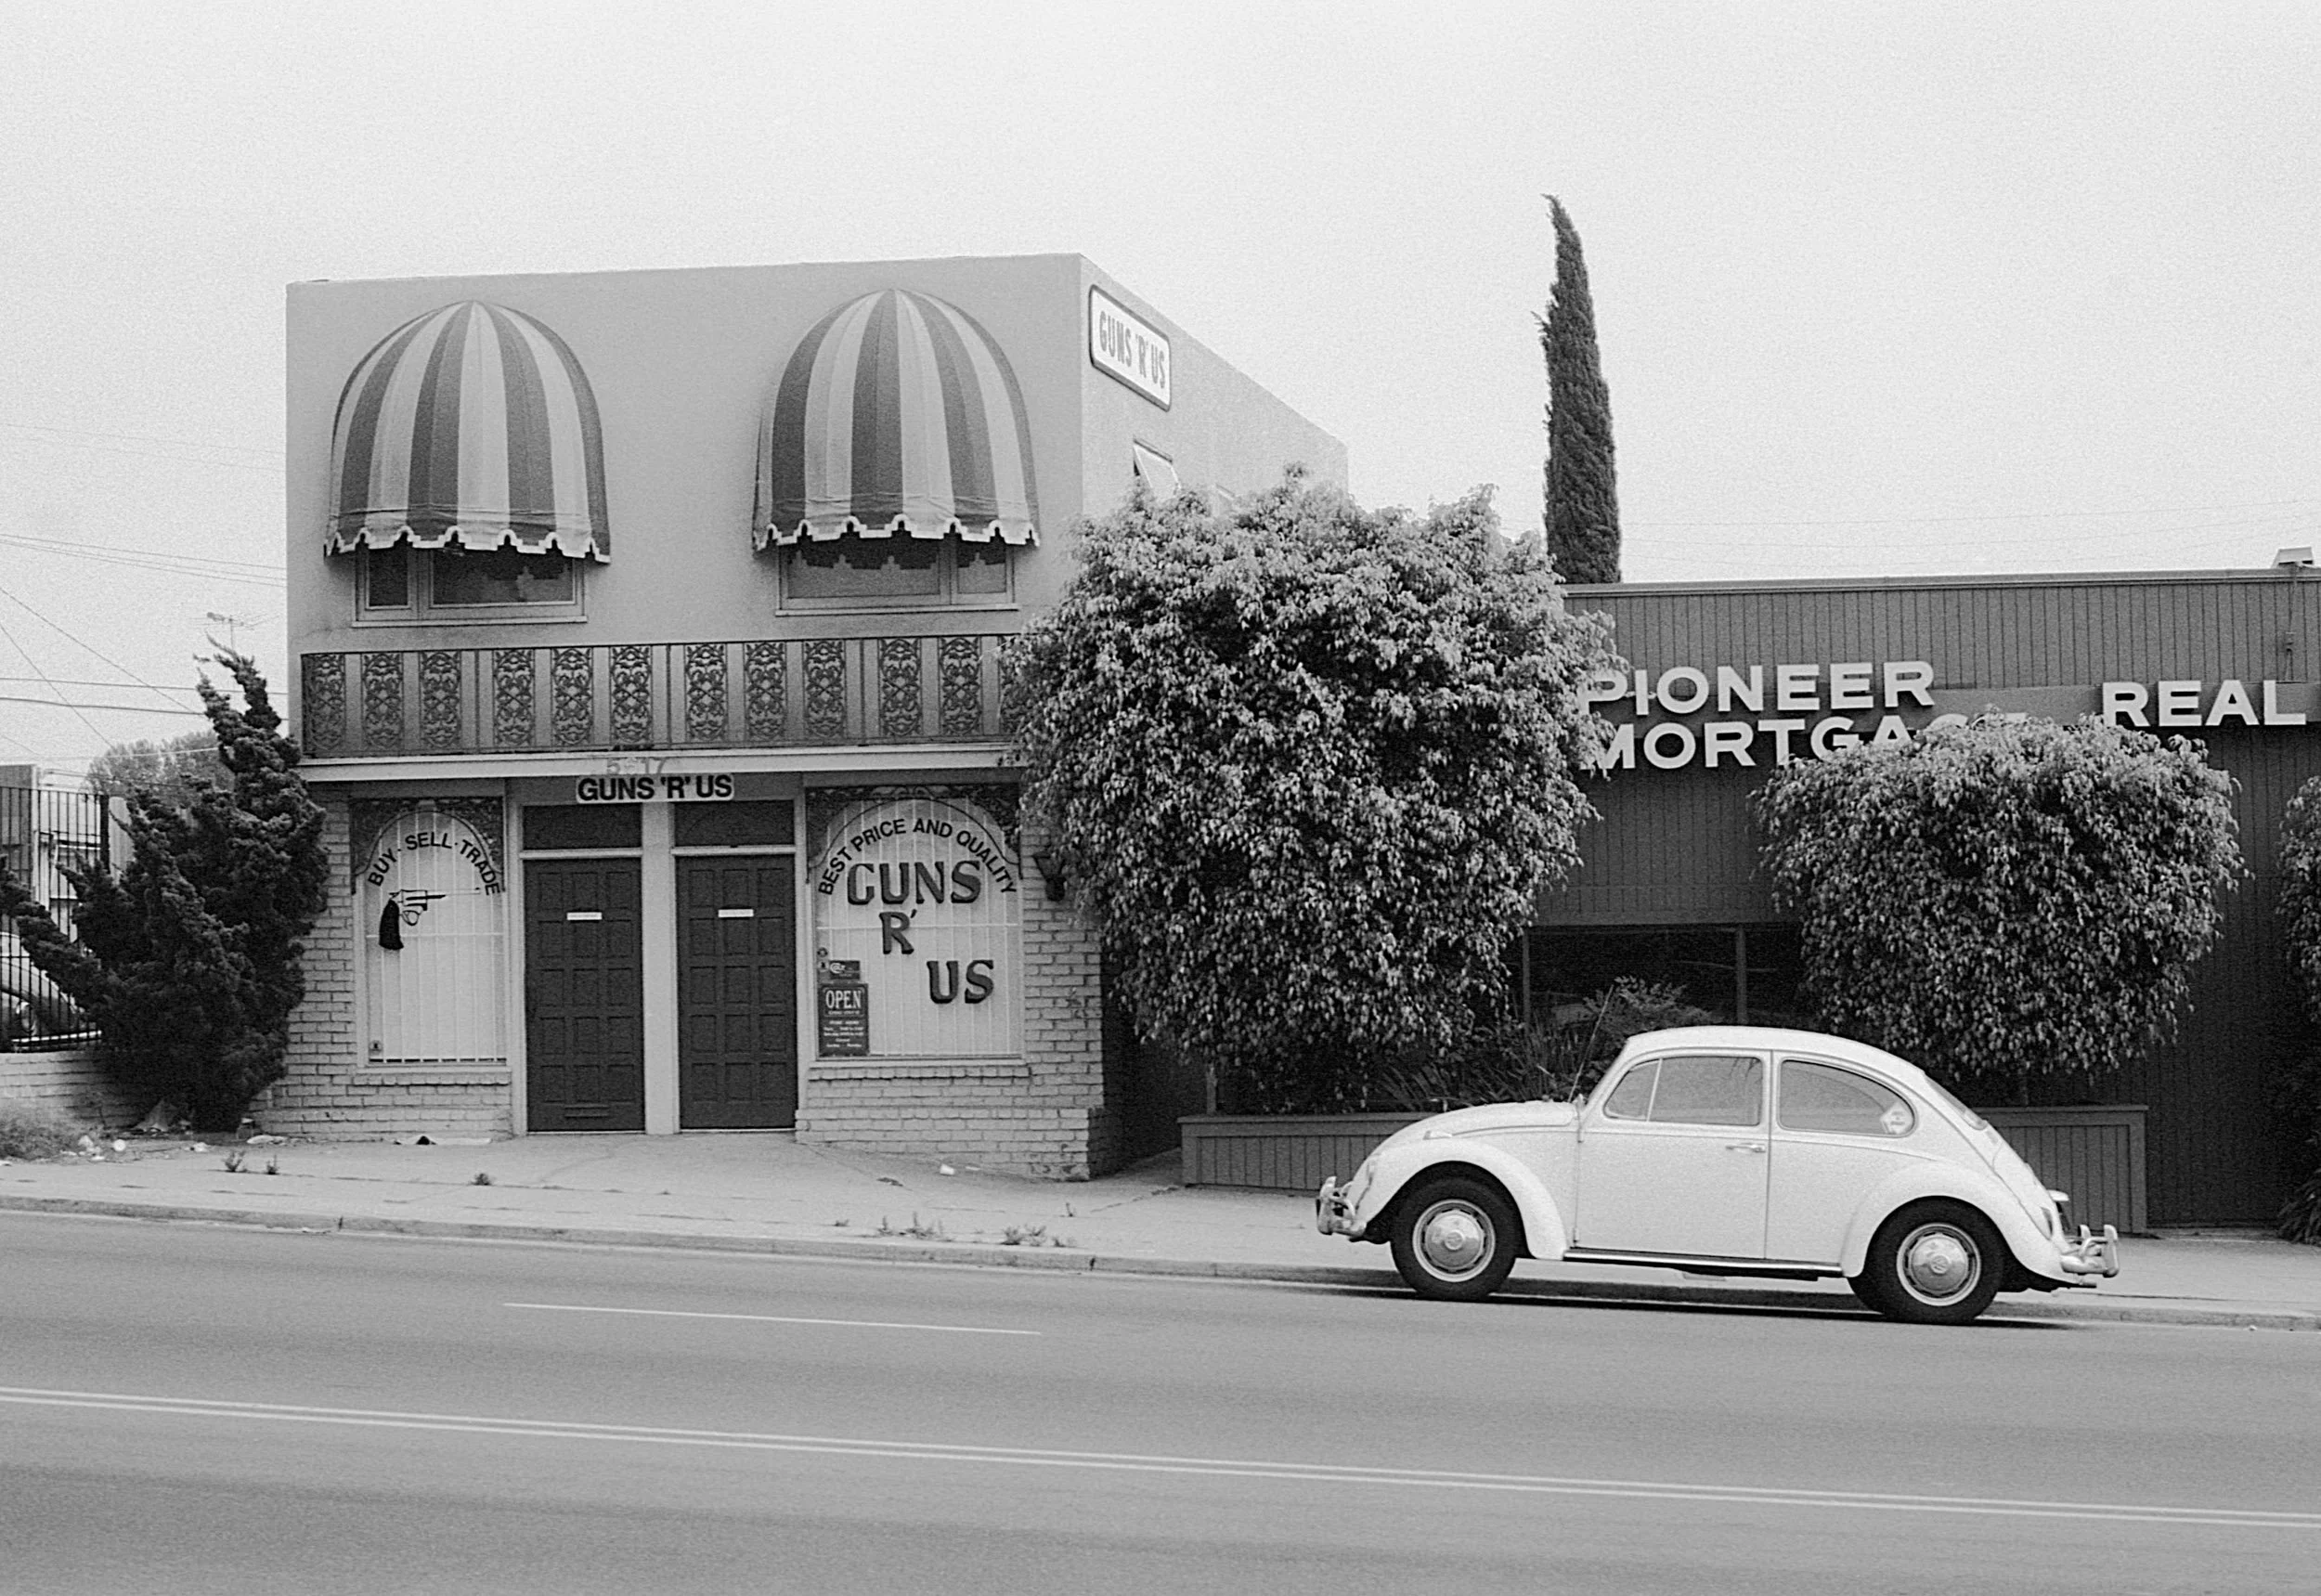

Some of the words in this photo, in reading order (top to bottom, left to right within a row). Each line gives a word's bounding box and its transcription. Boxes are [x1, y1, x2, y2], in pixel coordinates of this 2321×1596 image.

[1099, 310, 1132, 368] GUNS
[1151, 344, 1165, 389] US
[1578, 660, 1935, 715] PIONEER
[2103, 680, 2306, 727] REAL
[577, 777, 655, 801] GUNS
[660, 775, 692, 799] 'R'
[696, 774, 733, 798] US
[368, 848, 397, 887] BUY
[405, 832, 452, 850] SELL
[460, 839, 501, 896] TRADE
[818, 846, 852, 895] BEST
[850, 818, 907, 851] PRICE
[913, 818, 953, 838] AND
[956, 830, 1018, 894] QUALITY
[847, 860, 982, 906] GUNS
[878, 908, 917, 955] R'
[825, 990, 862, 1009] OPEN
[926, 959, 994, 1005] US
